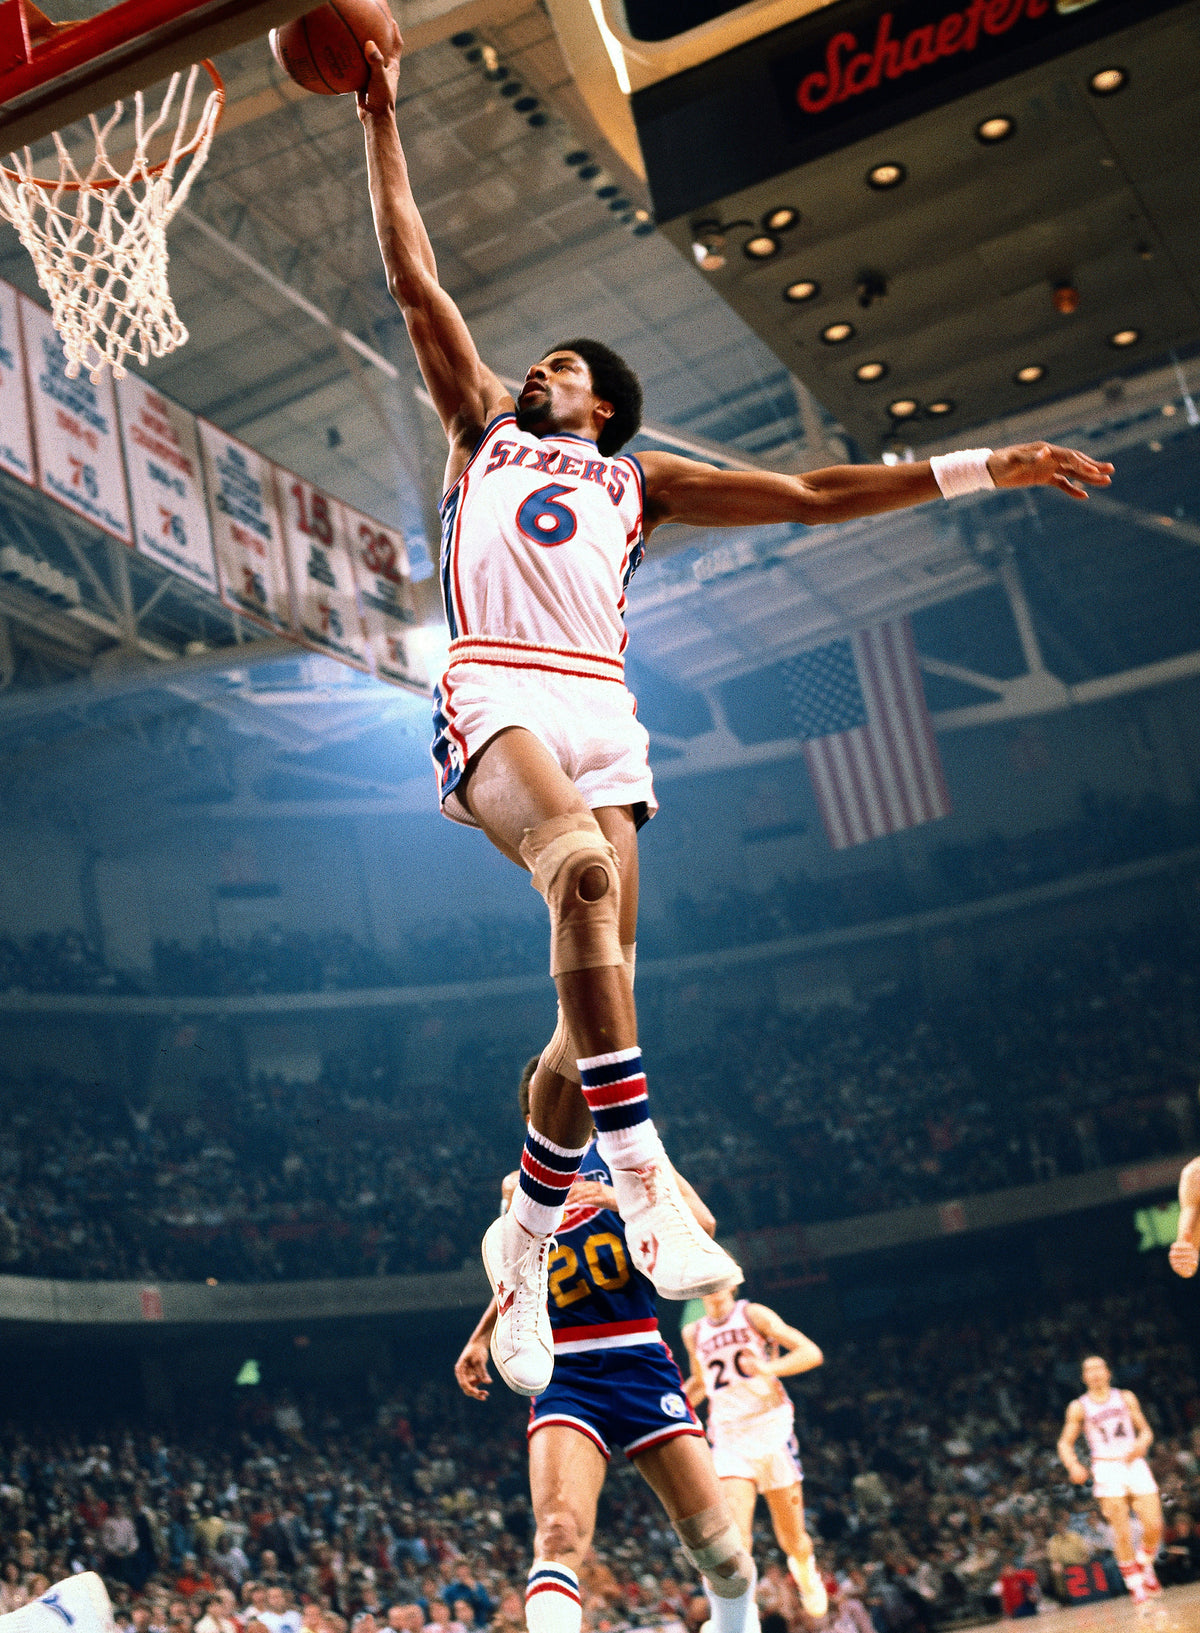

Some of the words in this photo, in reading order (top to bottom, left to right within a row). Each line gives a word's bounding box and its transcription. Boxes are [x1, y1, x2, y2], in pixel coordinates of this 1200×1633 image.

[483, 440, 630, 506] SIXERS
[515, 482, 578, 548] 6
[358, 522, 403, 586] 32
[548, 1232, 631, 1309] 20
[1098, 1420, 1128, 1445] 14
[1064, 1560, 1109, 1598] 21
